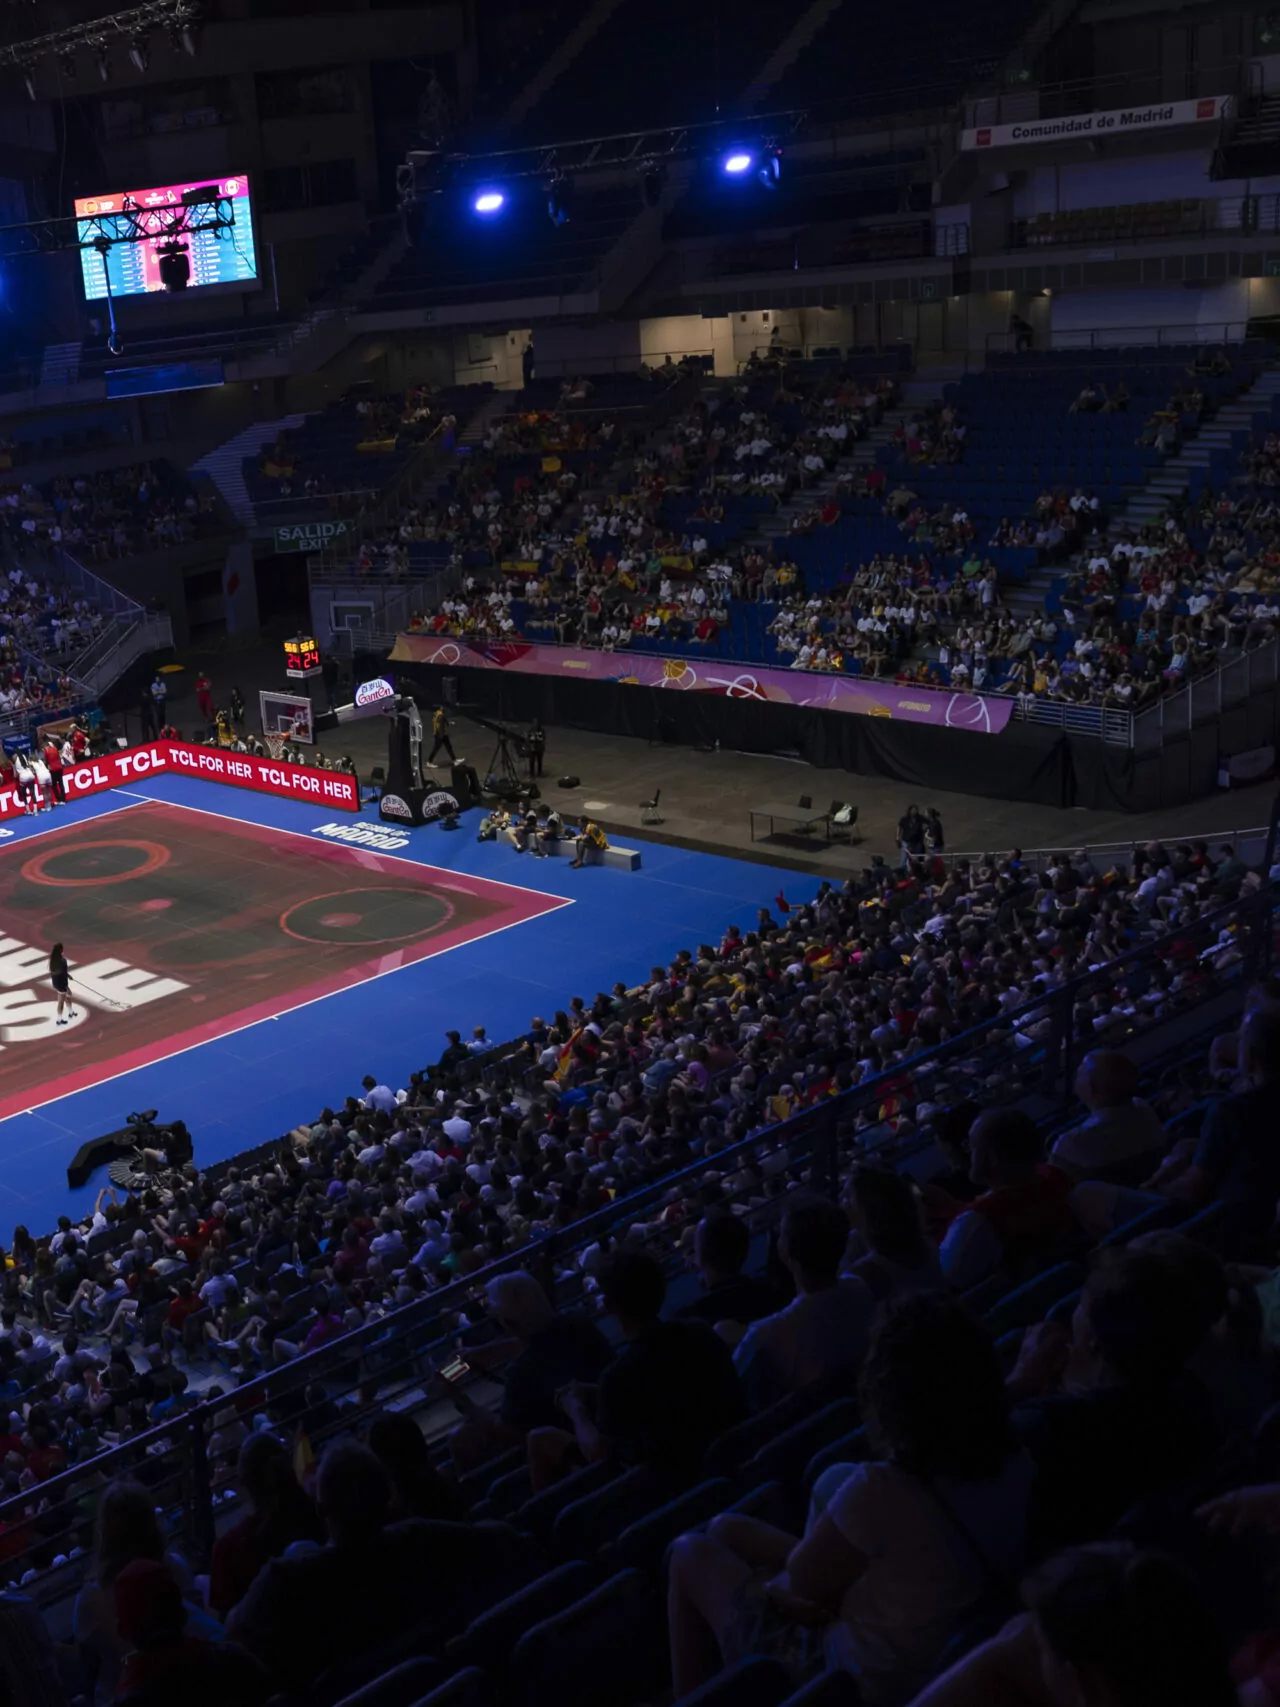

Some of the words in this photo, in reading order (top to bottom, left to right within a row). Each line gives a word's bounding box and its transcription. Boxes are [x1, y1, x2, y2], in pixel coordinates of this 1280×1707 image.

[1012, 117, 1092, 140] Comunidad
[1096, 115, 1115, 129] de
[1120, 107, 1174, 126] Madrid
[278, 522, 348, 542] SALIDA
[299, 537, 331, 550] EXIT
[287, 653, 301, 669] 24
[303, 651, 319, 669] 24
[62, 765, 109, 794] TCL
[115, 748, 166, 777] TCL
[169, 748, 198, 768] TCL
[199, 754, 224, 773] FOR
[227, 760, 252, 779] HER
[258, 767, 290, 788] TCL
[292, 774, 320, 794] FOR
[323, 780, 352, 800] HER
[311, 822, 410, 850] MADRID
[353, 821, 393, 835] REGION
[391, 828, 411, 837] OF
